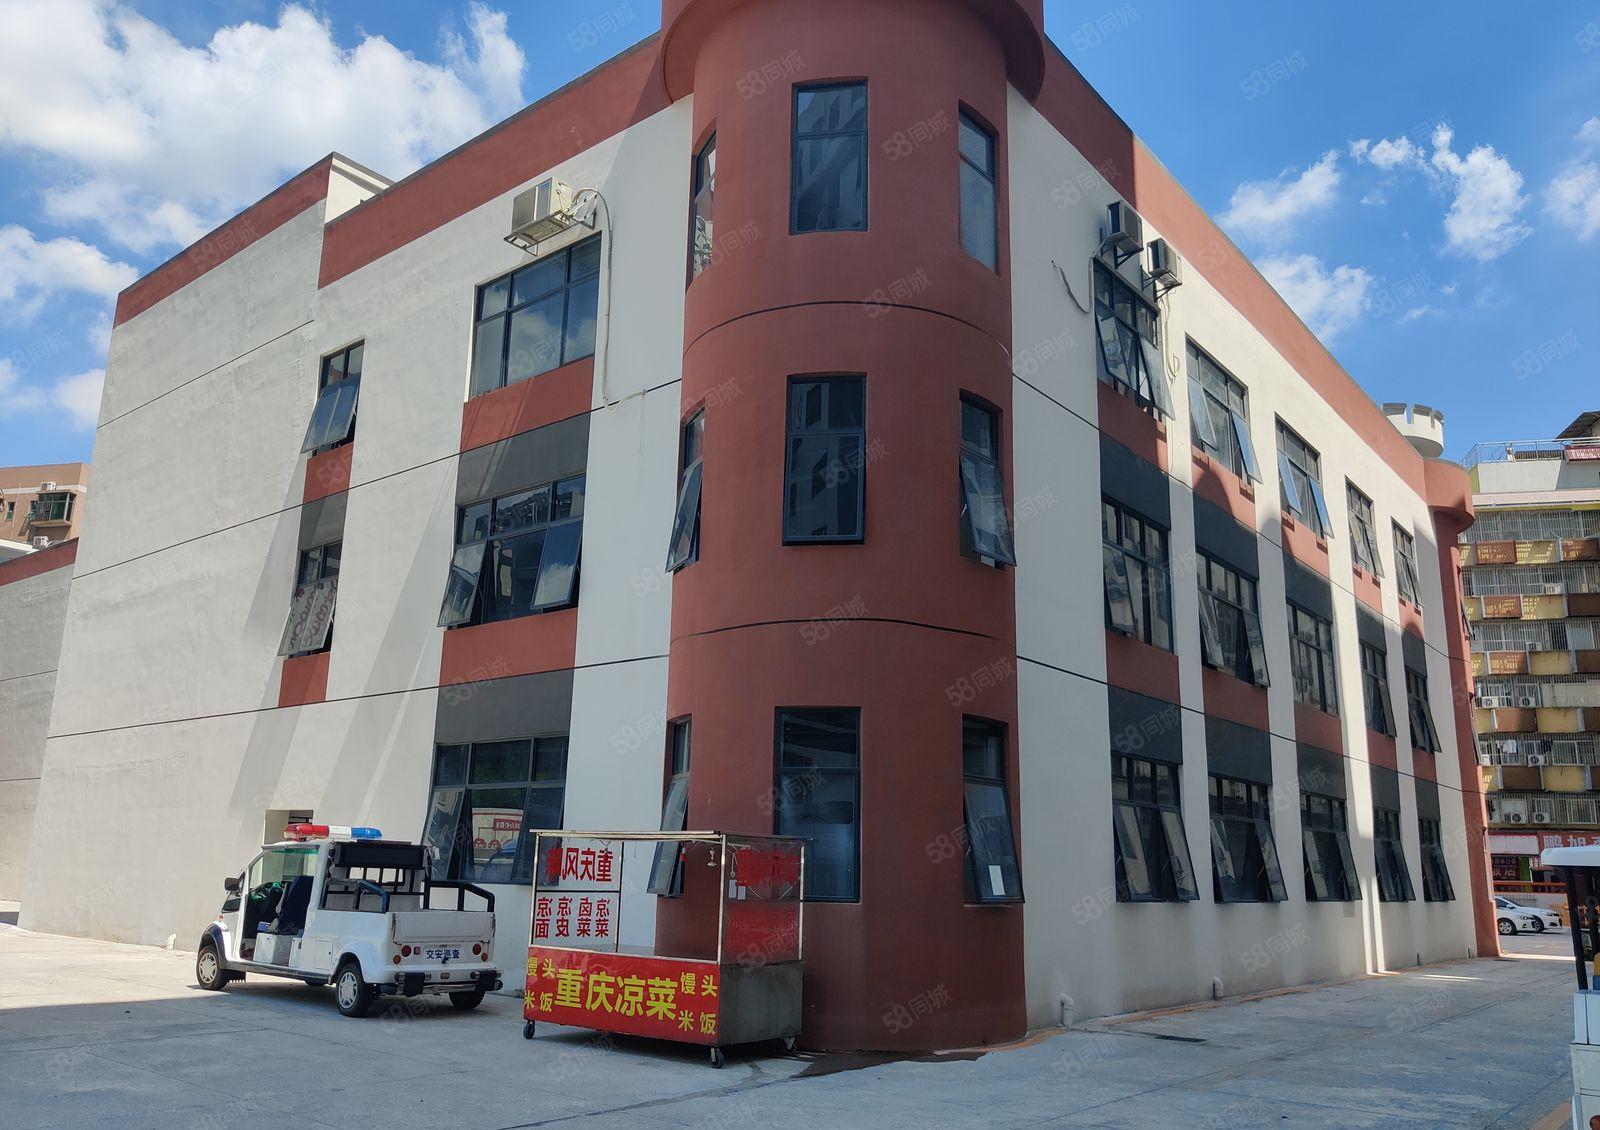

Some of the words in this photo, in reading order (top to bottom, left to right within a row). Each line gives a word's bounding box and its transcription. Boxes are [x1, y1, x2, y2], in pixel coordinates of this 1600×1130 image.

[527, 957, 556, 979] 馒头
[554, 968, 678, 1021] 重庆凉菜
[680, 971, 718, 998] 馒头
[524, 989, 554, 1013] 米饭
[678, 1009, 717, 1036] 米饭
